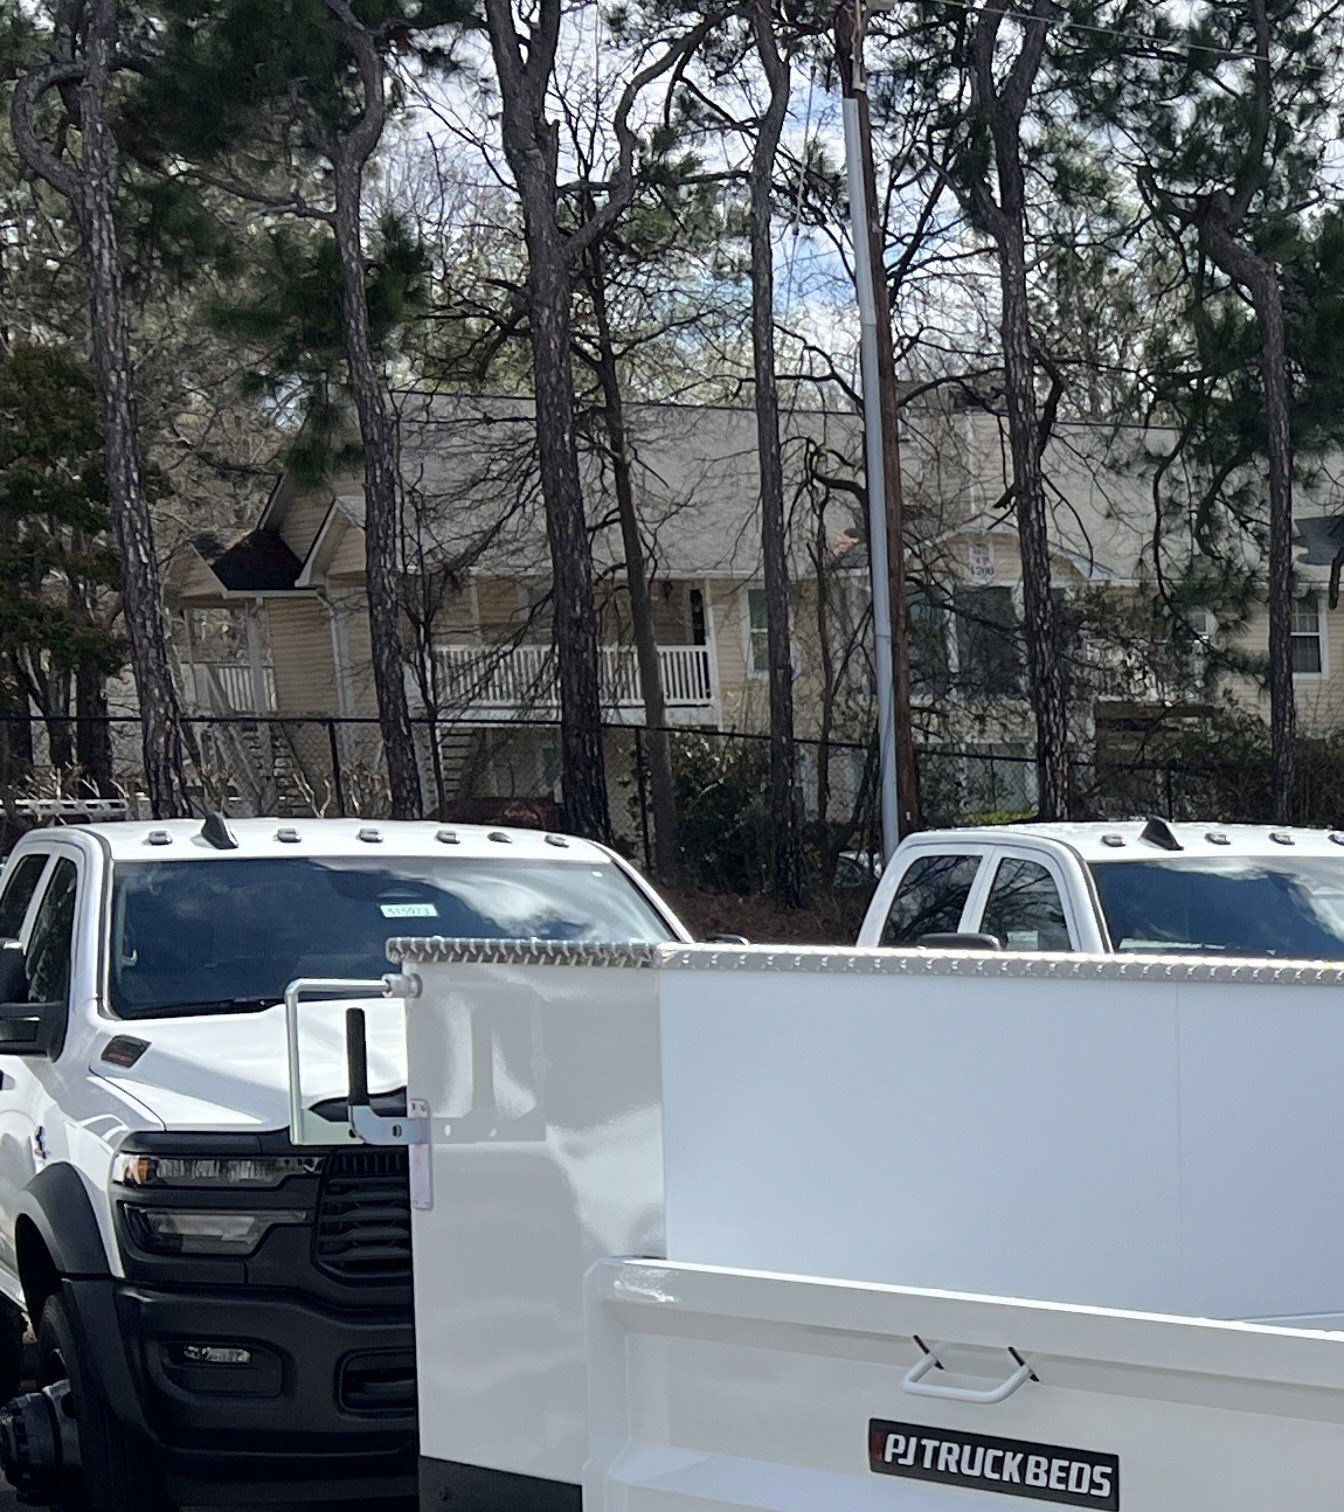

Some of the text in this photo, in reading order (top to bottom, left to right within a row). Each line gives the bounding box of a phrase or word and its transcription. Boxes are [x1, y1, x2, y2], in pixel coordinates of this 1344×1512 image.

[884, 1433, 1113, 1498] PJ TRUCK BEDS
